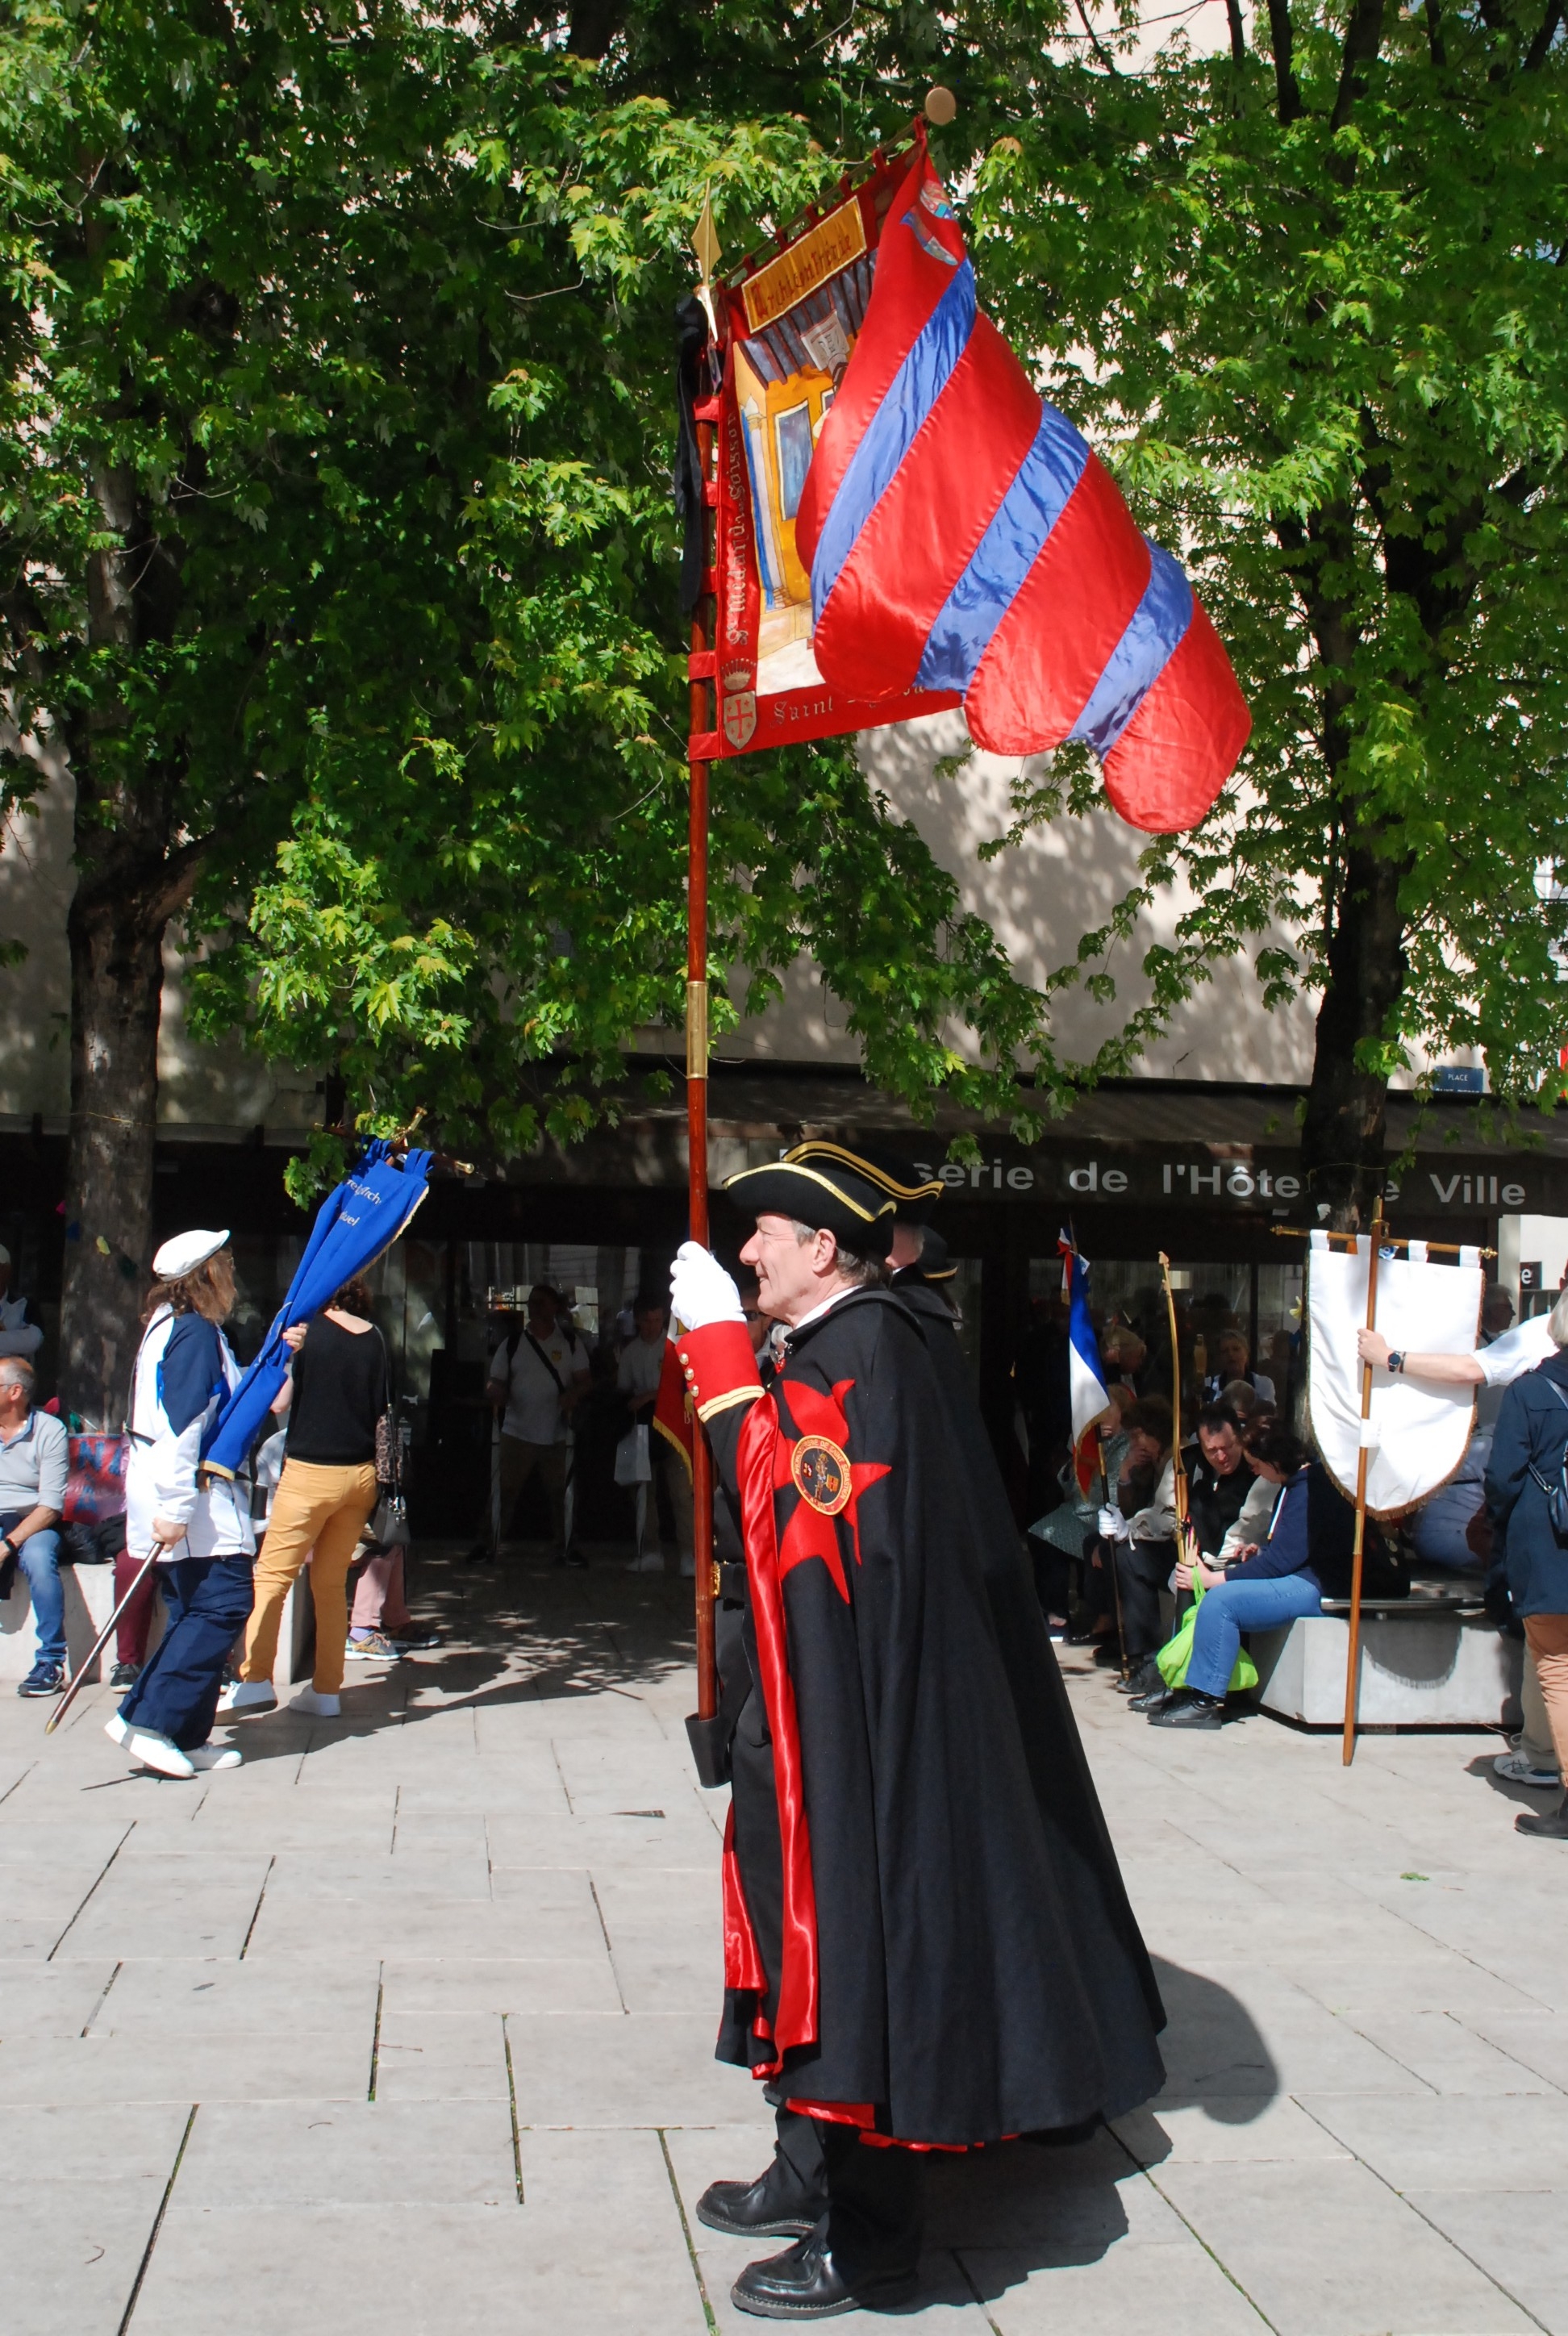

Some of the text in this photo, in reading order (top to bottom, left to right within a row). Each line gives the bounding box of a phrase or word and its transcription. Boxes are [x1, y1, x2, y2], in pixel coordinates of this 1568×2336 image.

[1447, 1074, 1469, 1082] PLACE
[913, 1158, 1034, 1190] serie
[1069, 1162, 1128, 1193] de
[1163, 1164, 1301, 1199] l'Hôte
[1429, 1174, 1526, 1206] Ville
